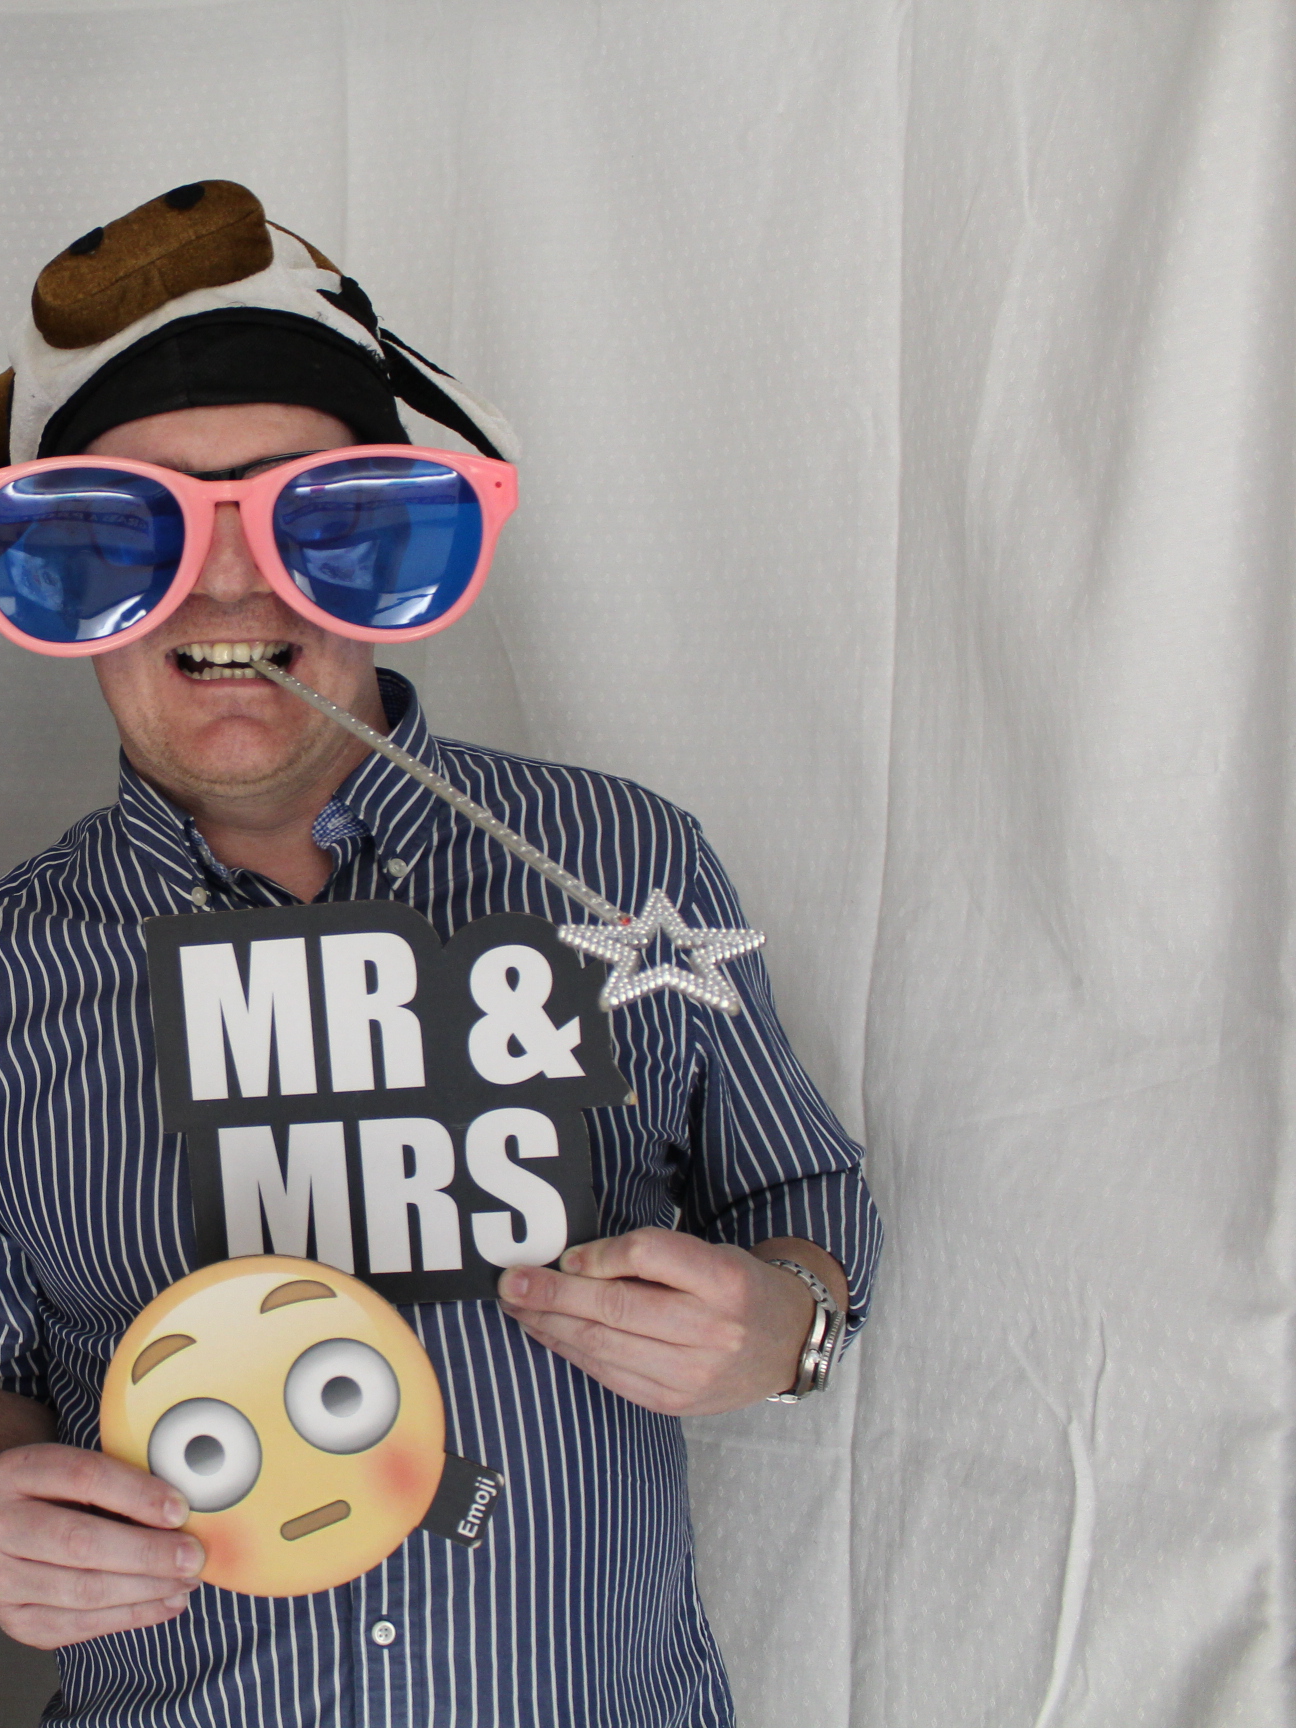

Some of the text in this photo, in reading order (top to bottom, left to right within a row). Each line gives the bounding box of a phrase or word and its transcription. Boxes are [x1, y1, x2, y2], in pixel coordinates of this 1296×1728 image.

[179, 932, 586, 1101] MR &
[217, 1107, 568, 1275] MRS
[457, 1476, 497, 1538] Emoji
